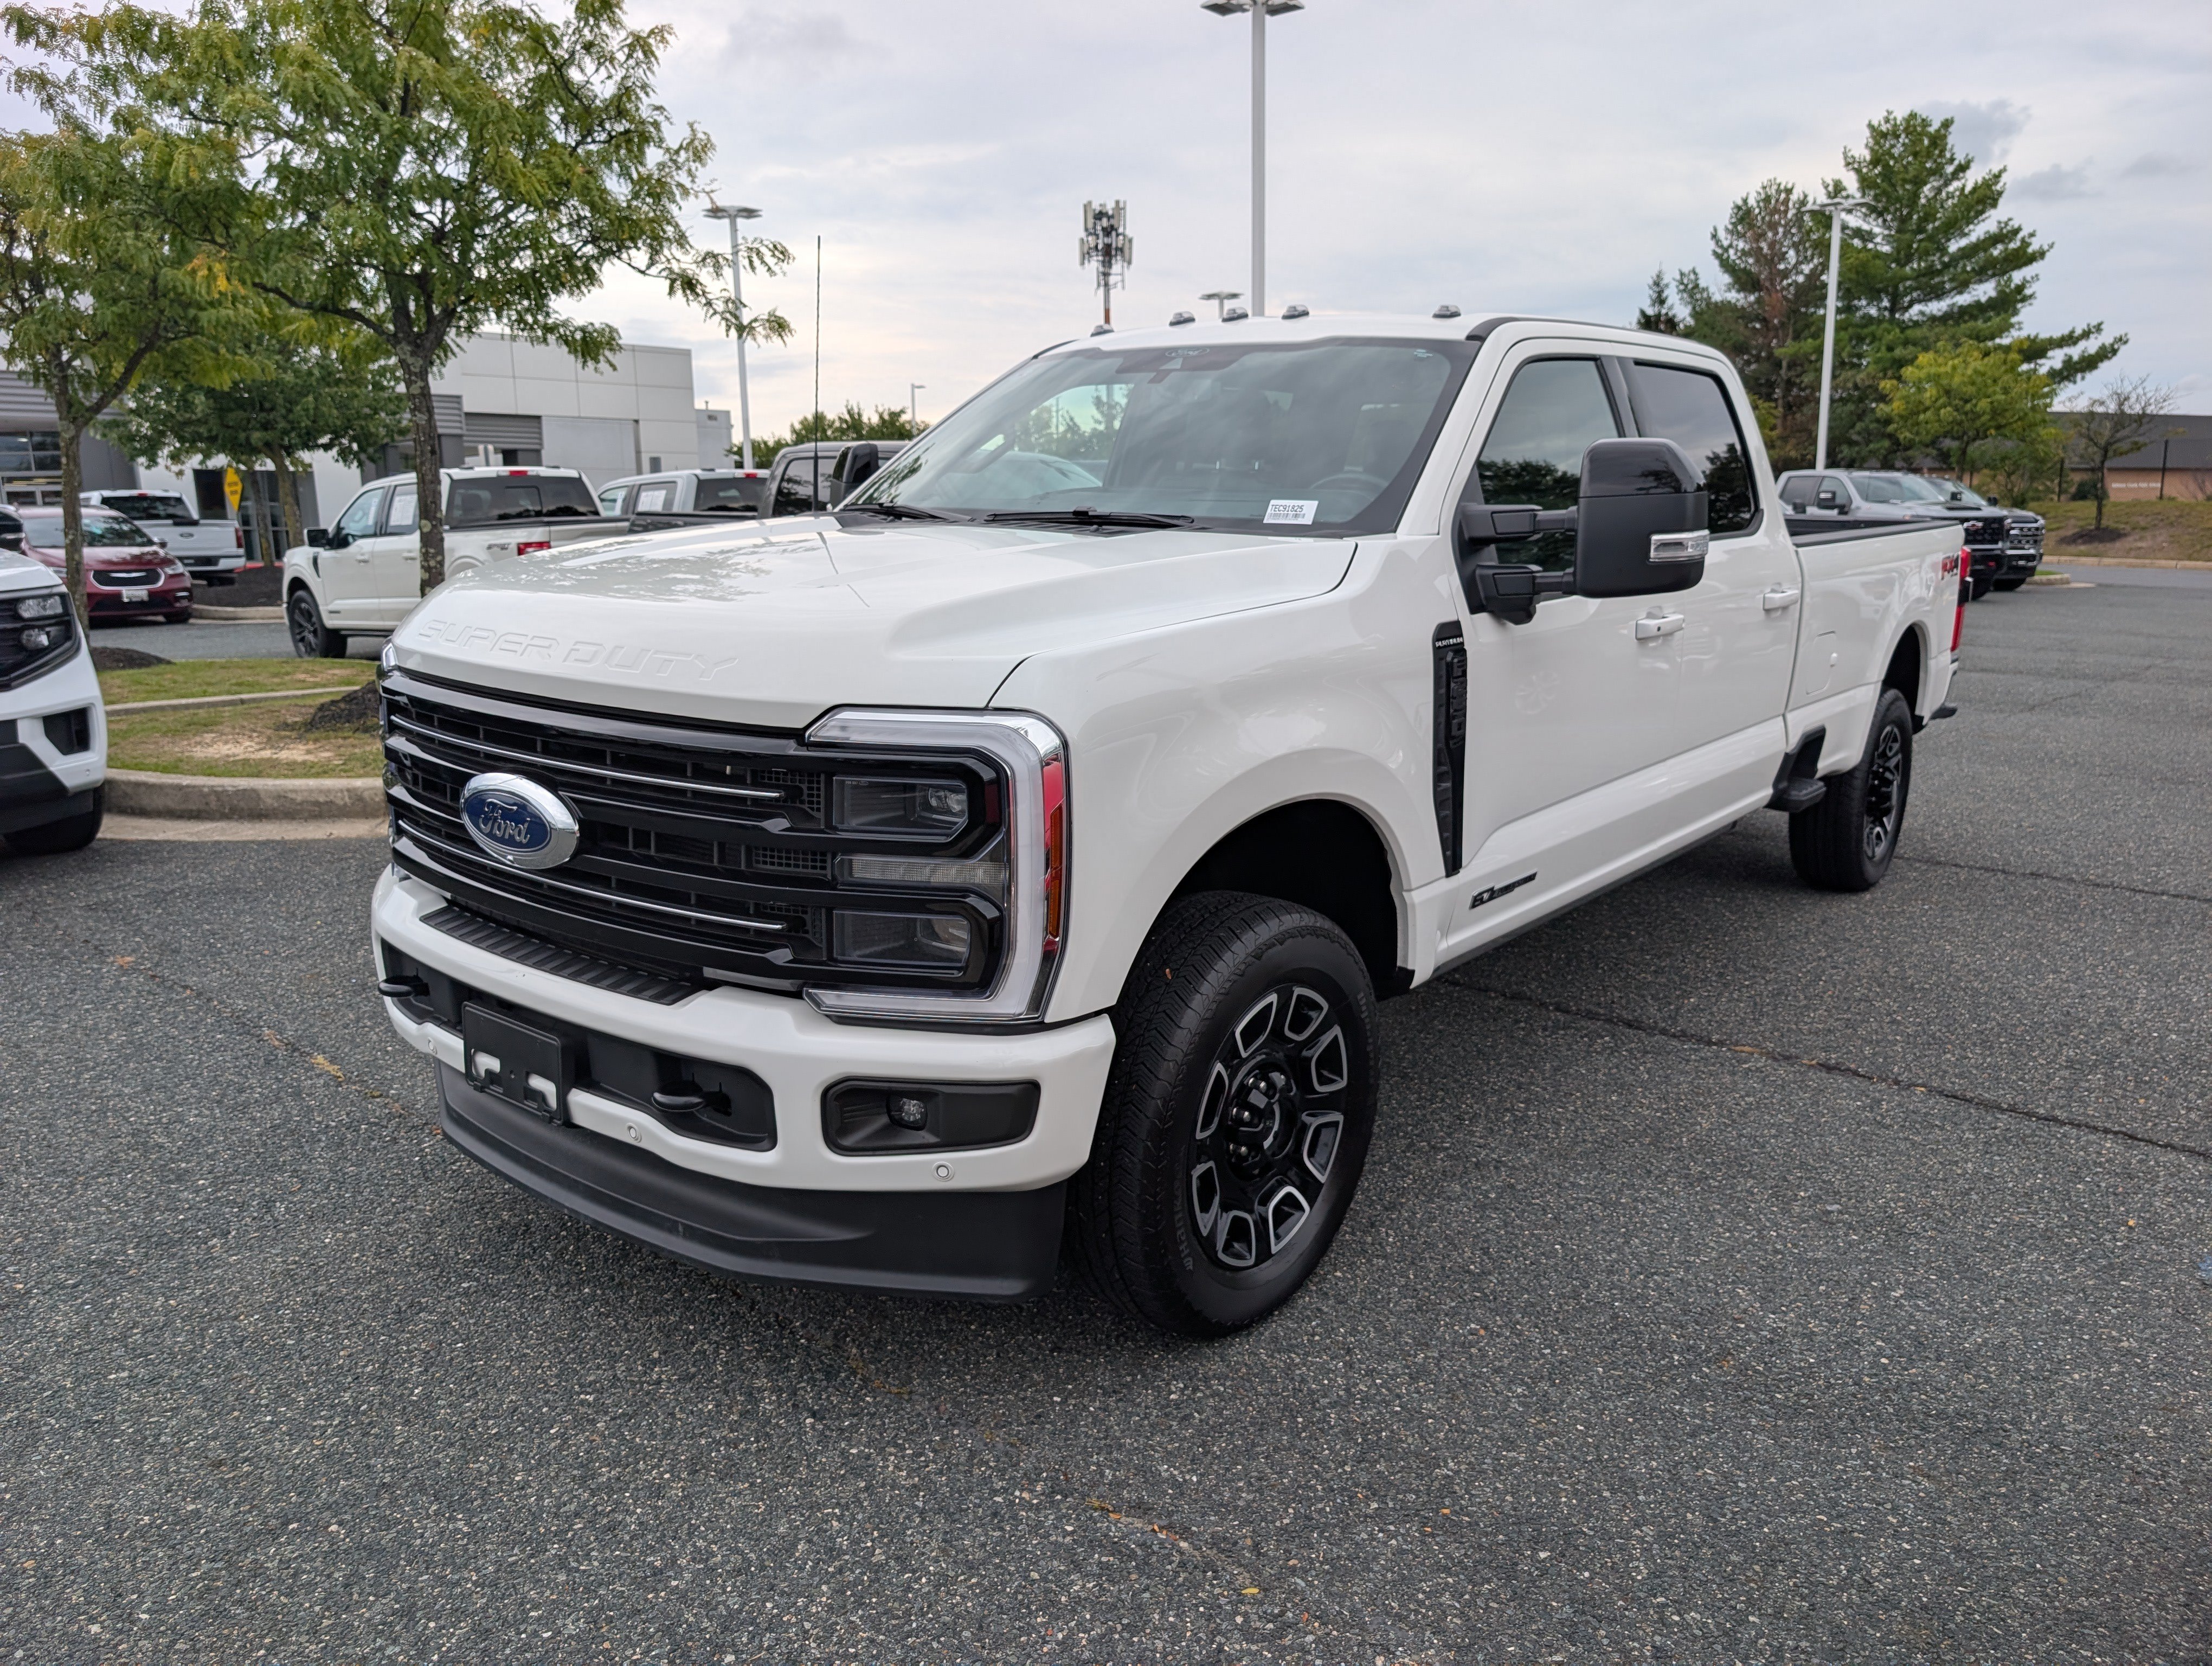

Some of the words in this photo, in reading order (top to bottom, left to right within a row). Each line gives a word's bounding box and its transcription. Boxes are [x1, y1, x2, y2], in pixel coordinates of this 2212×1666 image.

[1270, 504, 1304, 512] TEC91825
[417, 619, 560, 659] SUPER
[562, 640, 738, 681] DUTY
[479, 798, 531, 844] Ford
